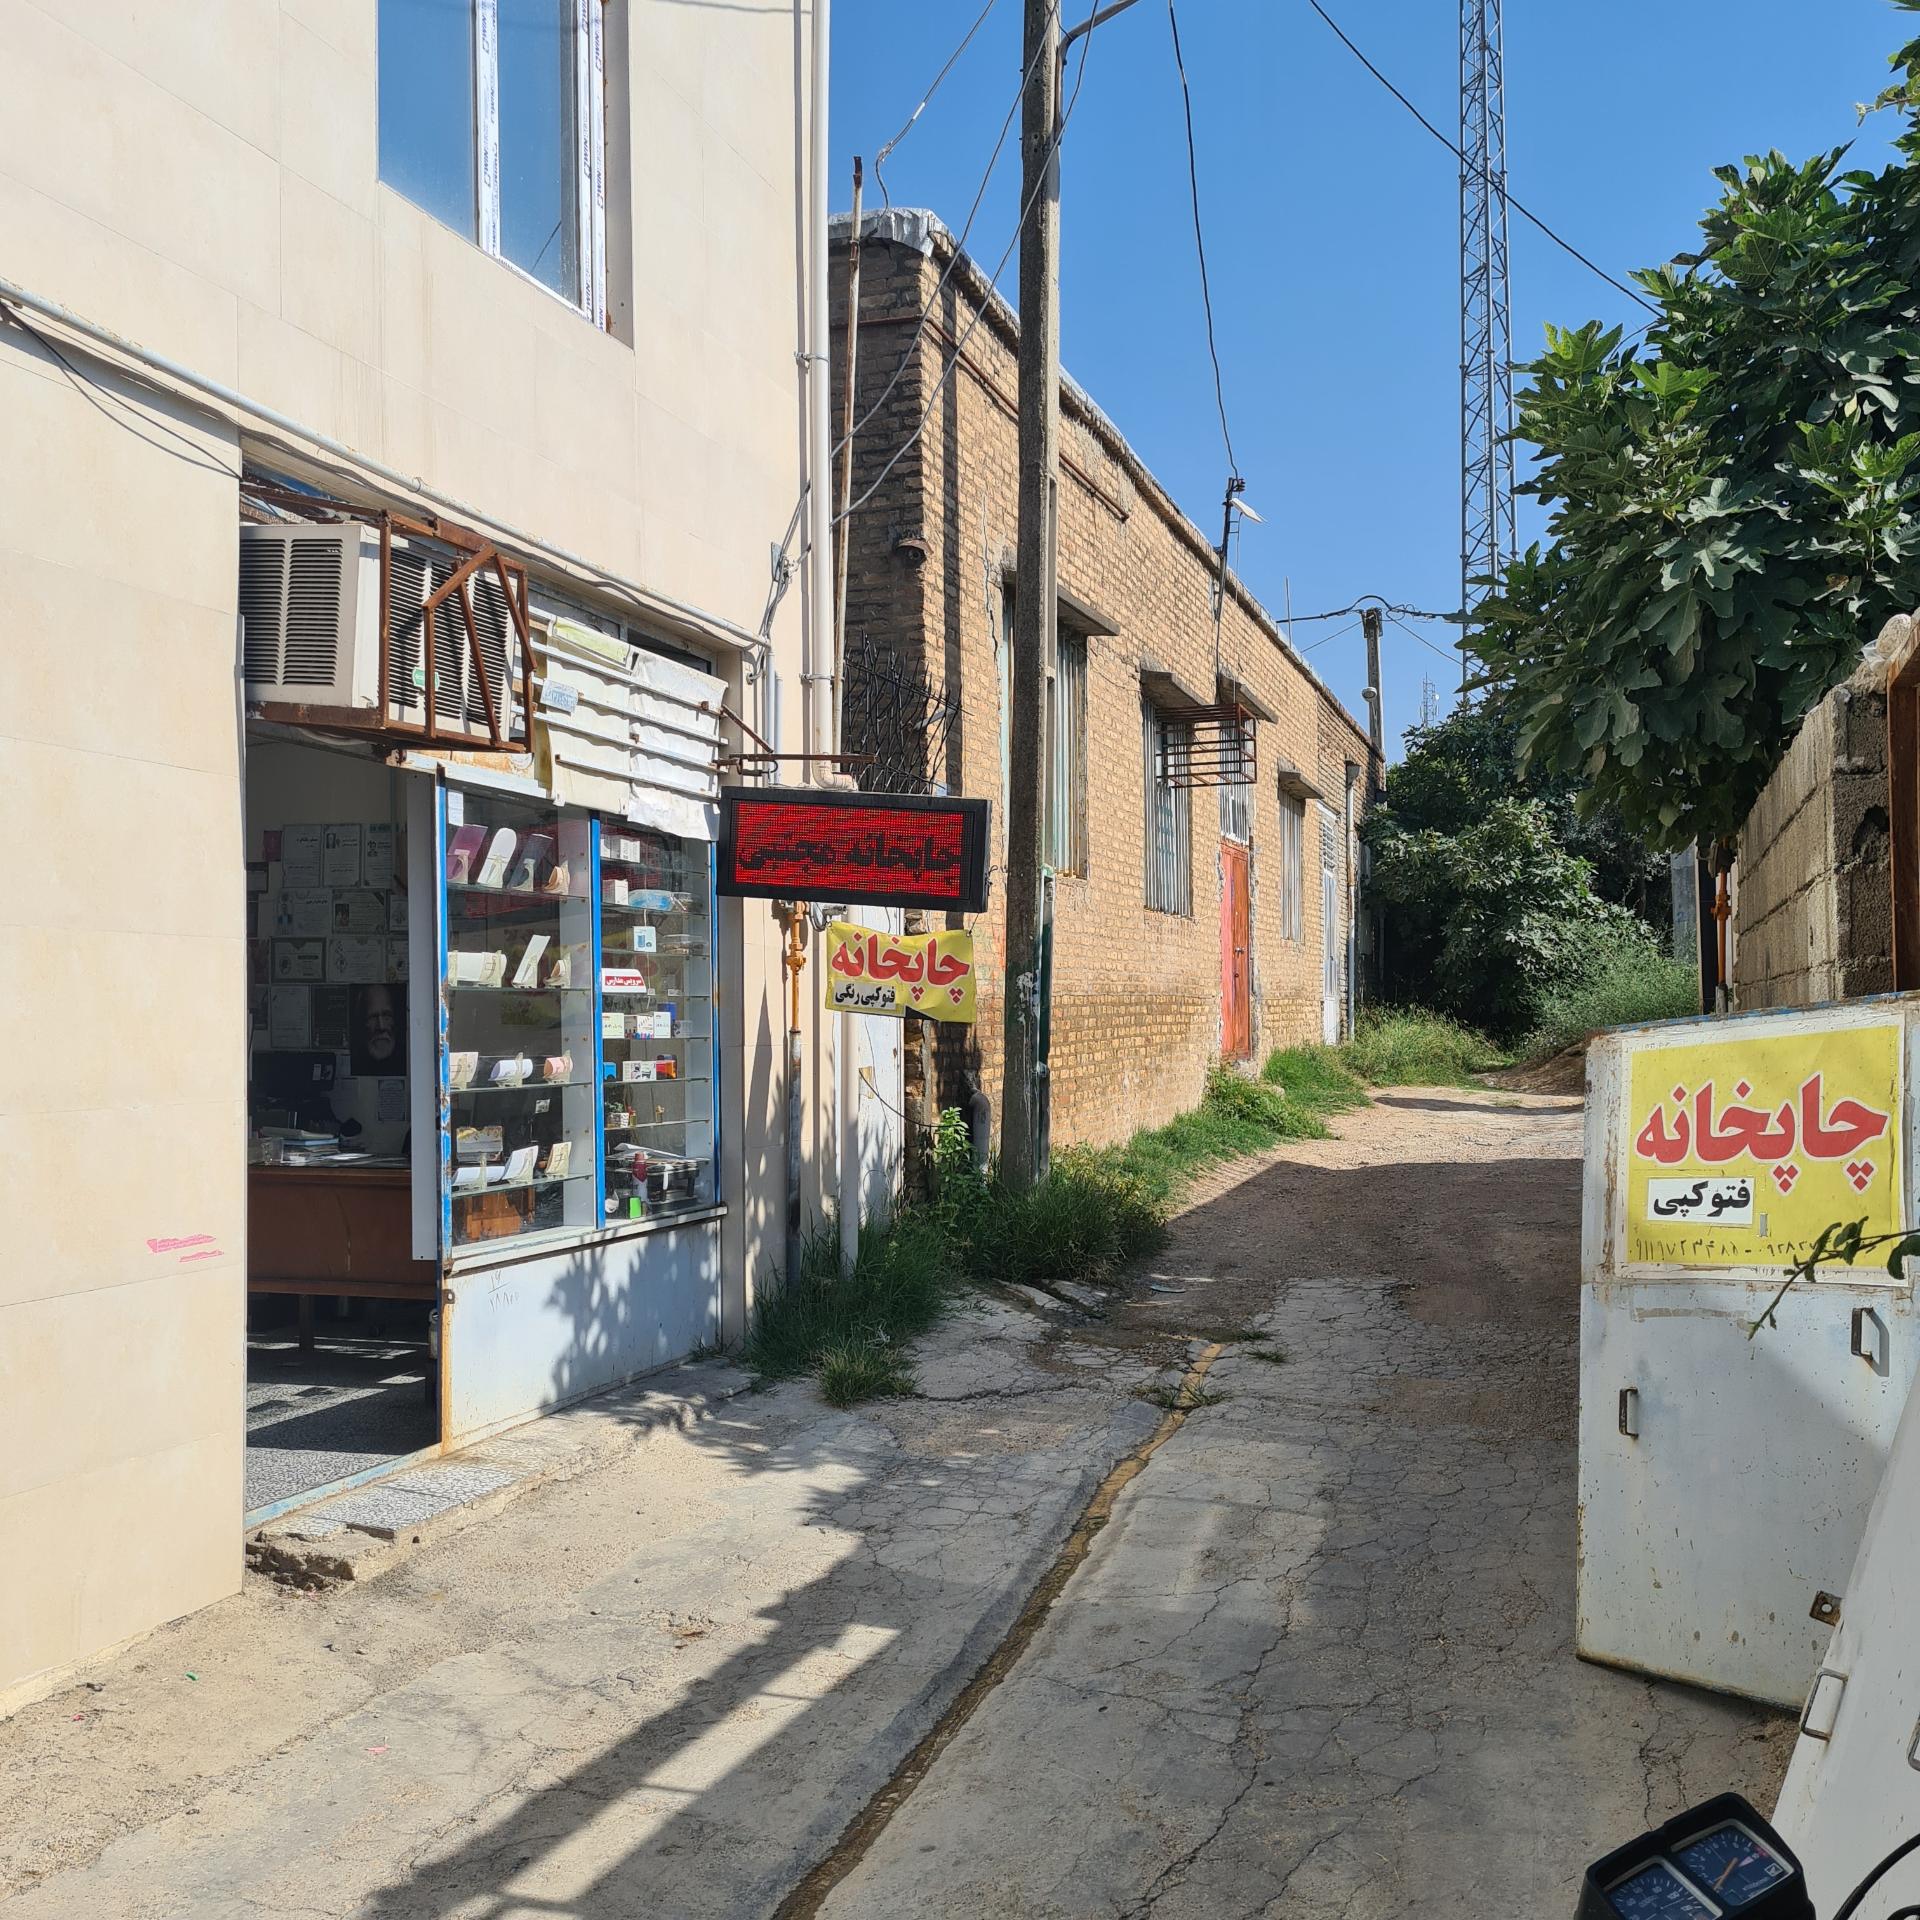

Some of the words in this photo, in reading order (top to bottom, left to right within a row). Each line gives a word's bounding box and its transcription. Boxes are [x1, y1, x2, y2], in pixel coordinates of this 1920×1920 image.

[848, 831, 962, 886] چاپخانه
[624, 977, 642, 986] سرویس
[832, 932, 970, 1004] چاپخانه
[835, 983, 859, 1004] رنگی
[861, 986, 896, 1007] فتوکپی
[1637, 1074, 1888, 1193] چاپخانه
[1653, 1178, 1751, 1218] فتوکپی
